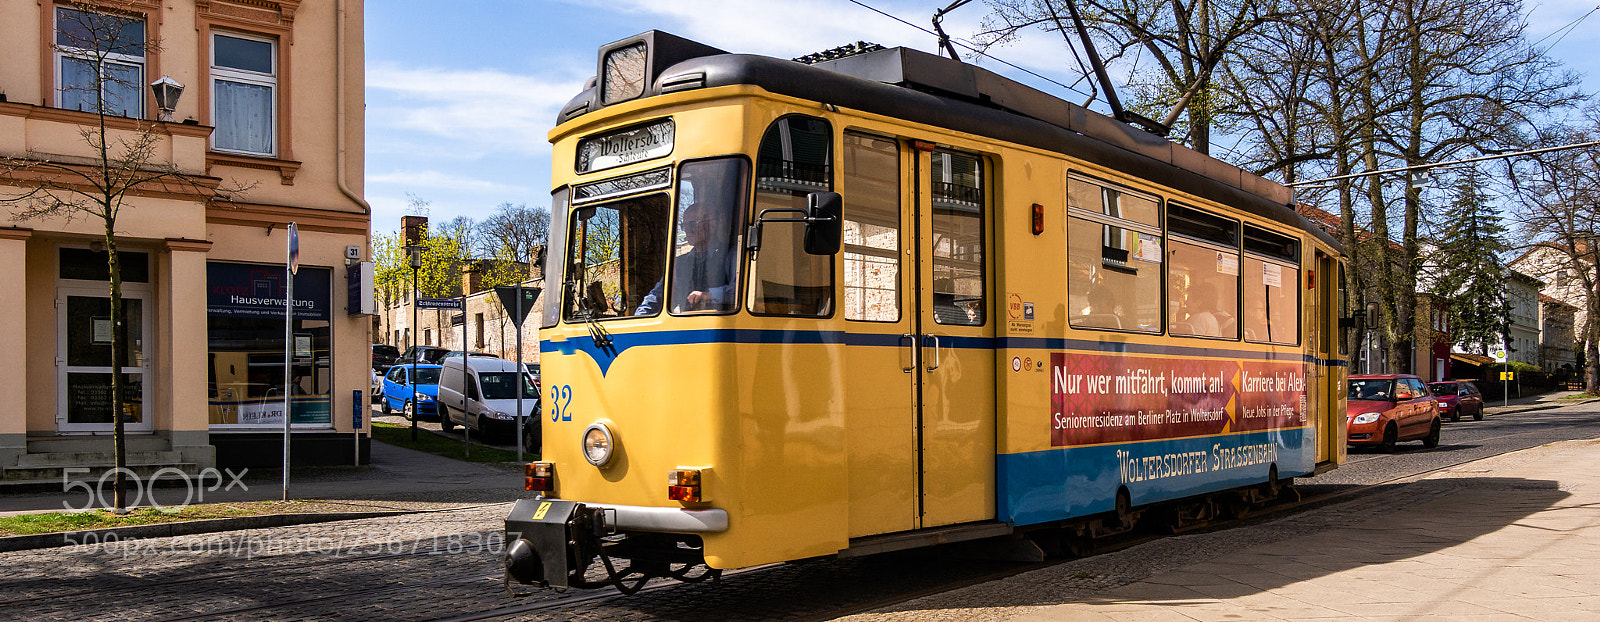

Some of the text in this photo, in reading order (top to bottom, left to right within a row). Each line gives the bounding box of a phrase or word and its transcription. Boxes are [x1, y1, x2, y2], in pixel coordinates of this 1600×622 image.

[350, 248, 358, 256] 31
[212, 285, 249, 296] KLOTZ
[231, 295, 314, 309] Hausverwatung
[1054, 365, 1224, 397] Nur wer mitfährt, kommt an!
[1242, 370, 1274, 393] Karriere
[1275, 371, 1287, 392] bei
[551, 384, 572, 423] 32
[1242, 403, 1294, 419] Neue Jobs in der Pflege
[1054, 406, 1224, 430] Seniorenresidenz am Berliner Platz in Woltersdorf
[1116, 443, 1278, 484] WOLTERSDORFER STRASSENBAHN
